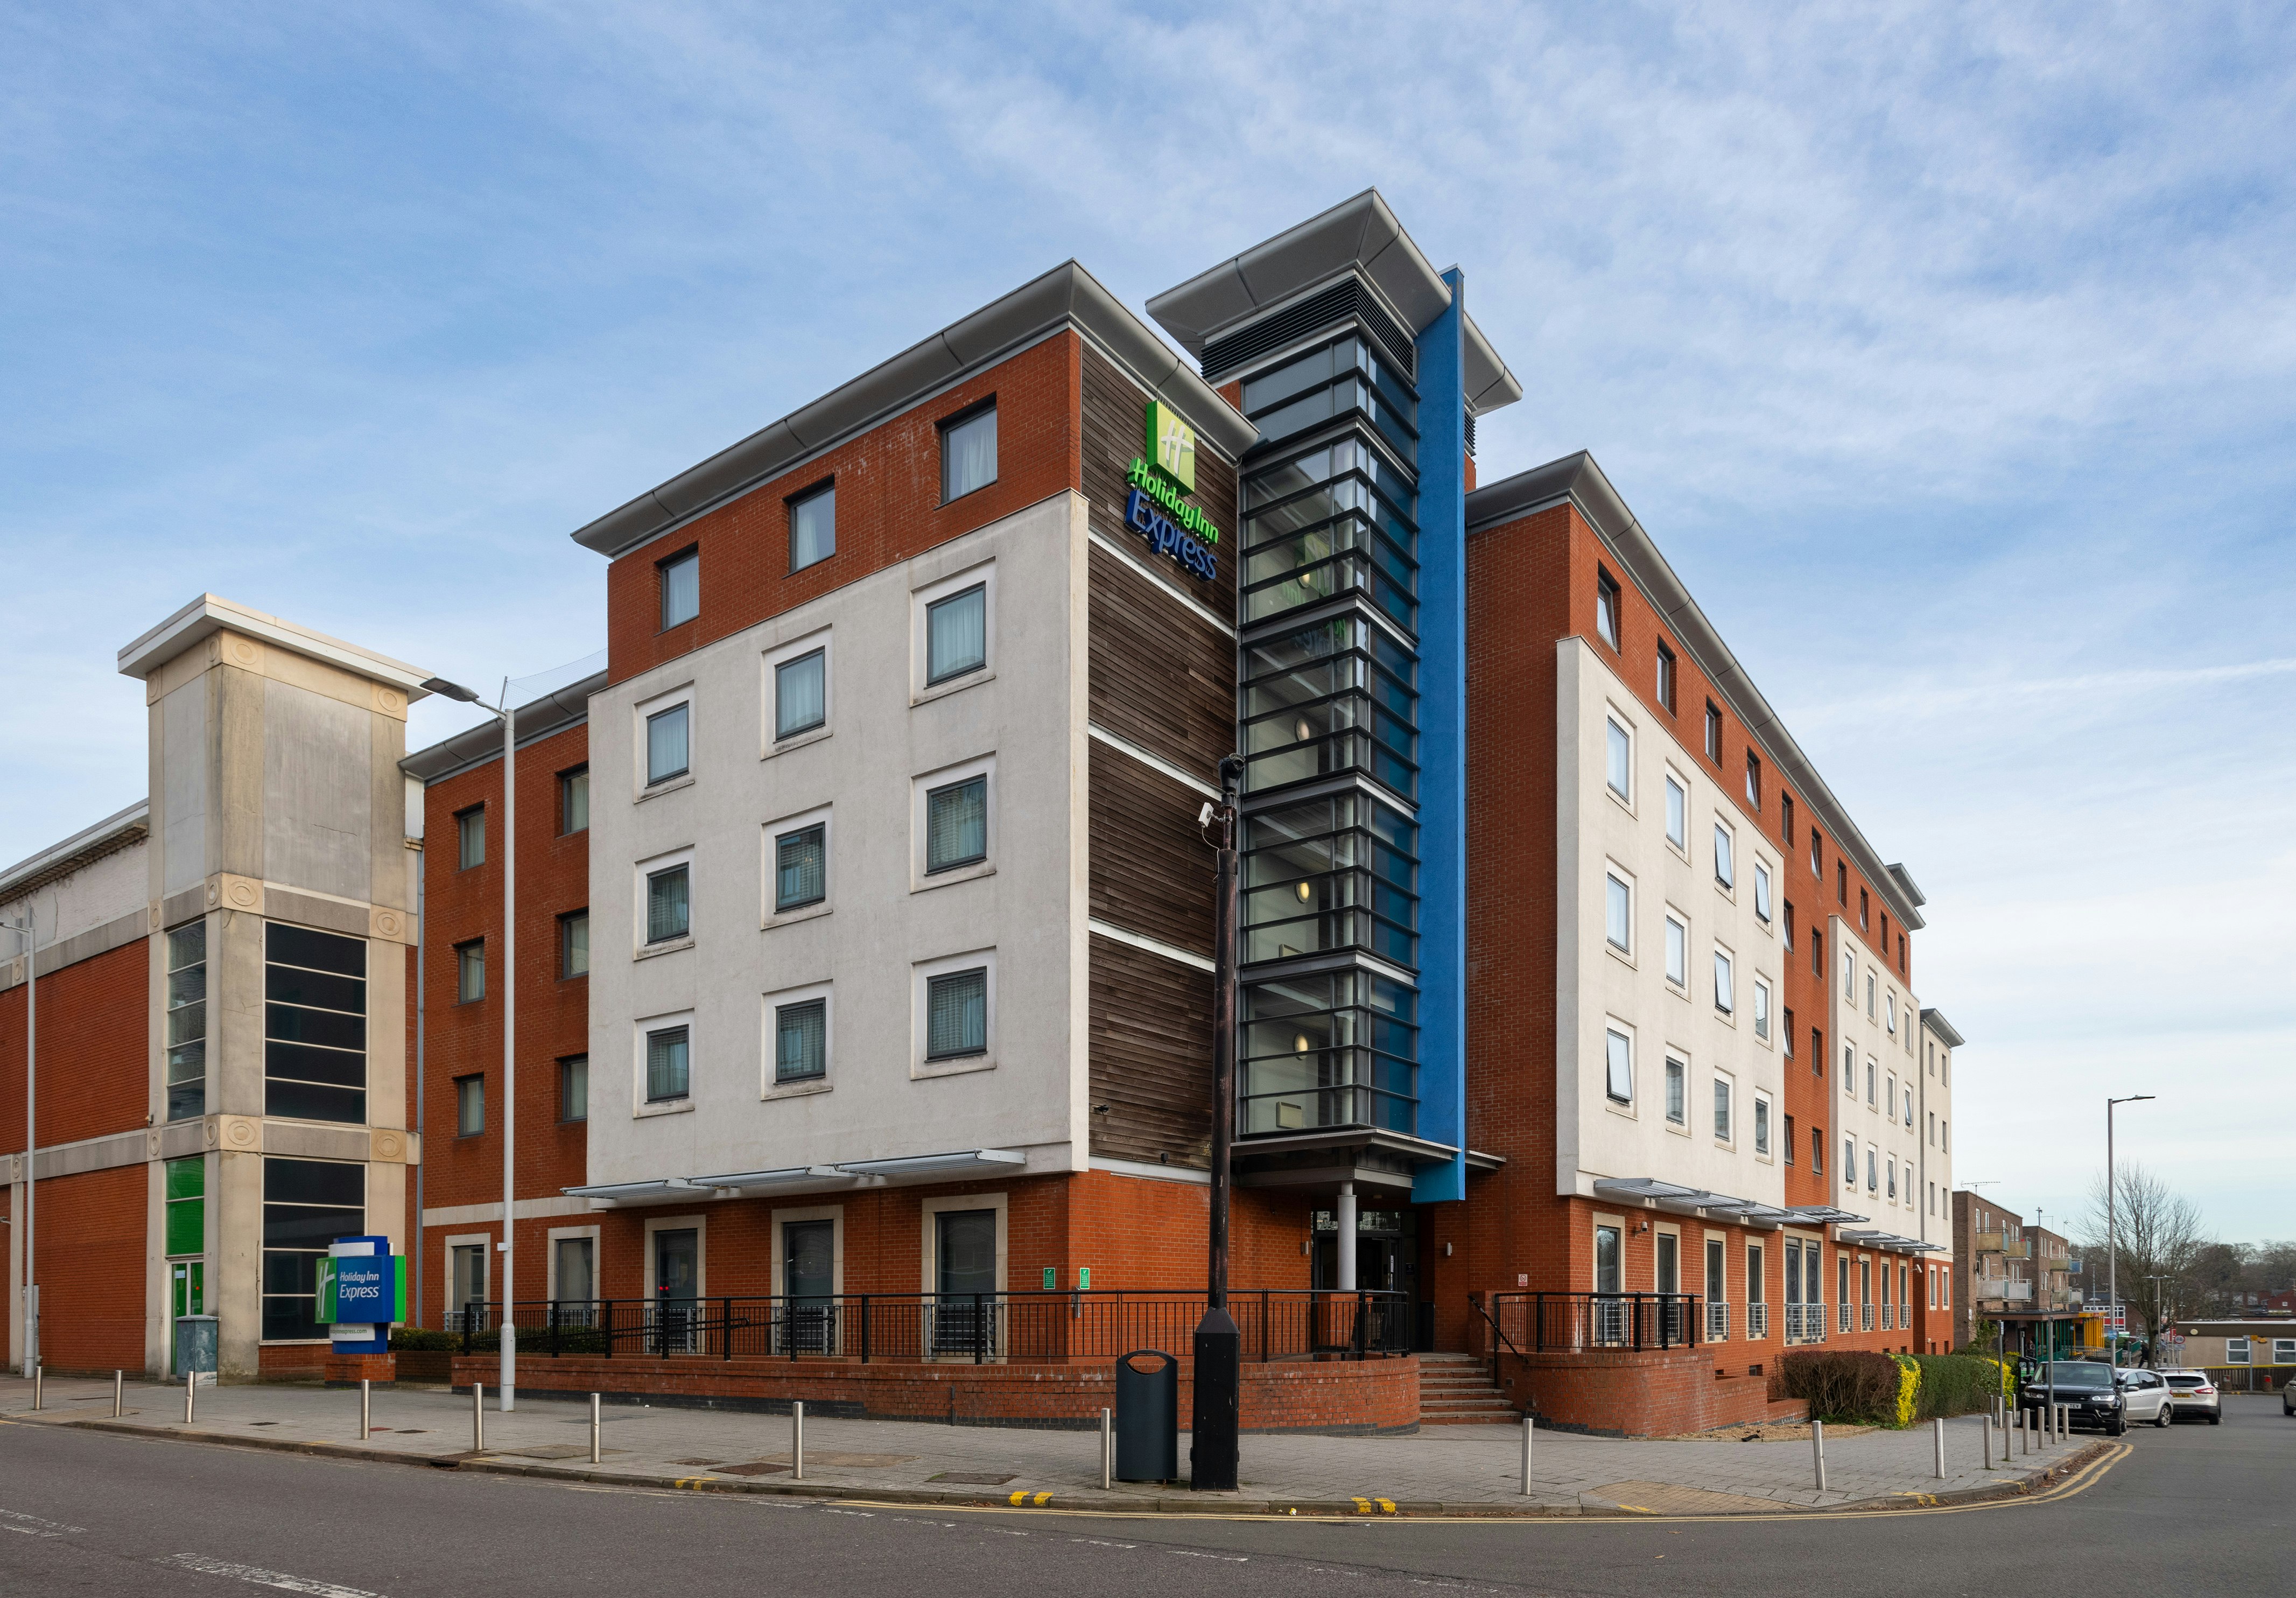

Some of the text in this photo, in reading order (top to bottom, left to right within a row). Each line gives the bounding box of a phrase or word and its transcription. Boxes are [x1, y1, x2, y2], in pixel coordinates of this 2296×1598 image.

[1129, 457, 1219, 544] Holiday Inn
[1128, 489, 1218, 580] Express
[340, 1271, 380, 1284] Holiday Inn
[340, 1284, 379, 1302] Express
